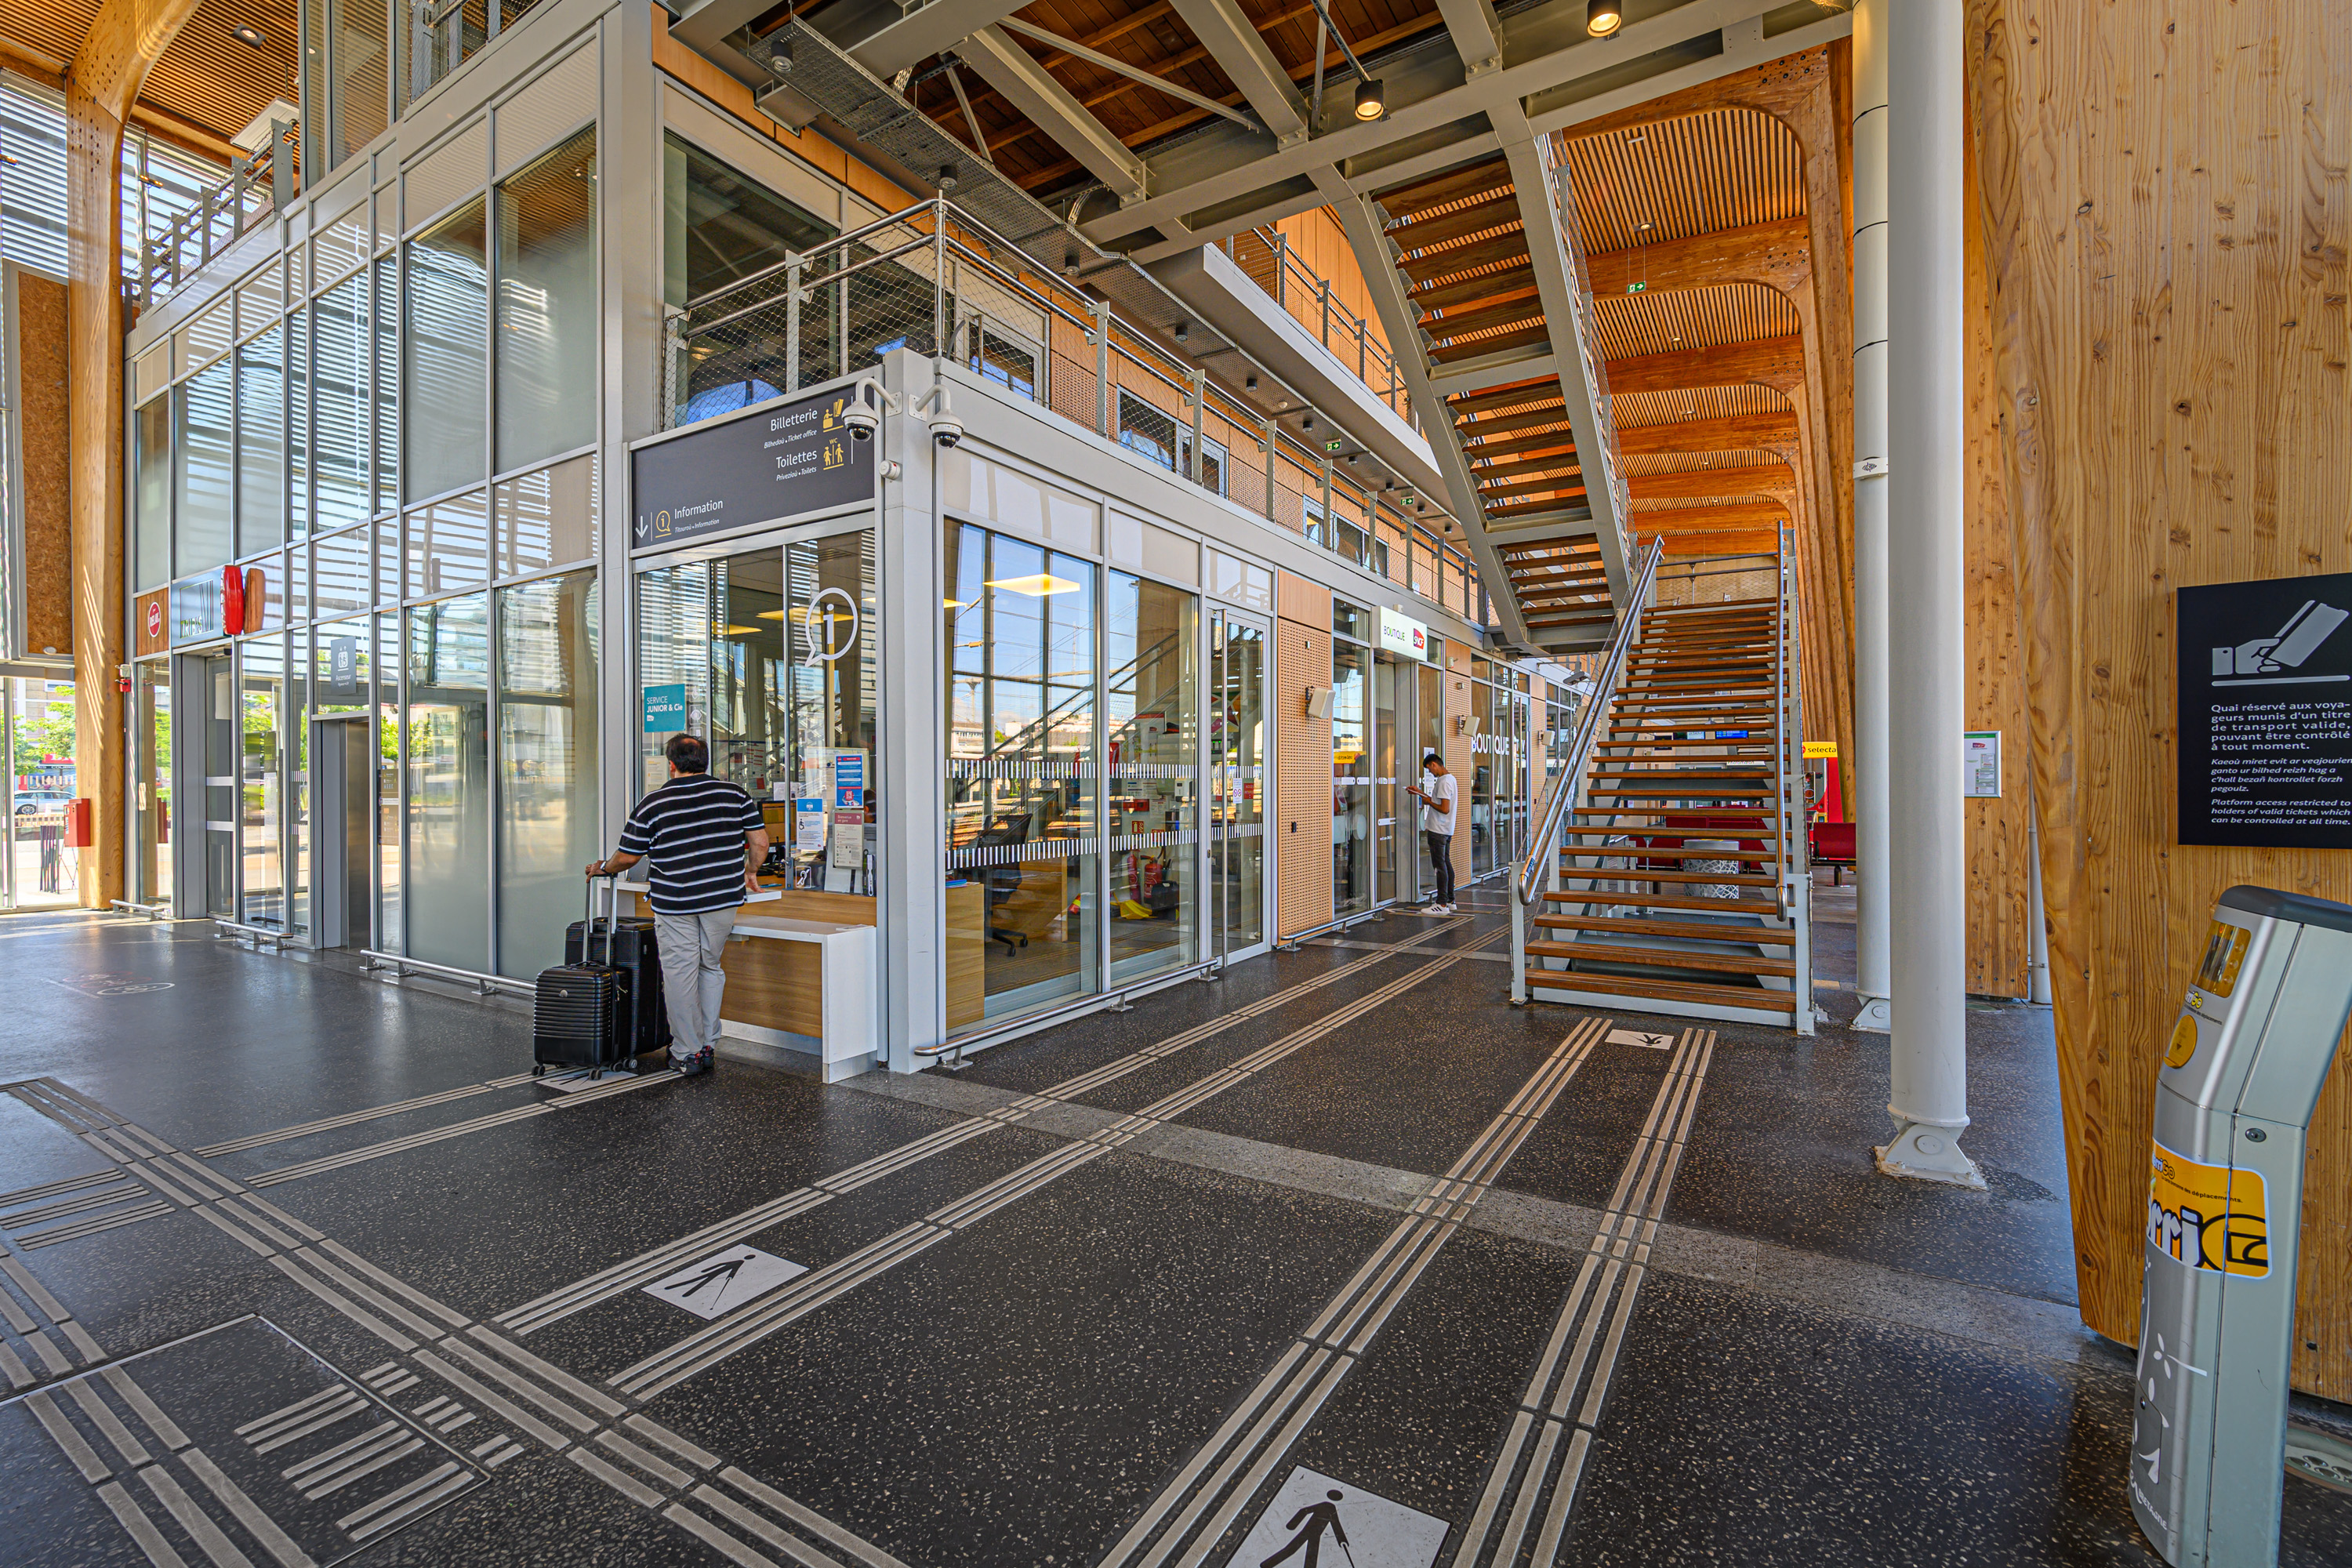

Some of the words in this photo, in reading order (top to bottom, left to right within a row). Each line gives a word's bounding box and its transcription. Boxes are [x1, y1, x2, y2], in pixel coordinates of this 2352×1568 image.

[771, 408, 817, 431] Billetterie
[764, 439, 784, 449] Bilhedoù
[788, 433, 802, 442] Ticket
[803, 430, 817, 438] office
[776, 451, 817, 468] Toilettes
[776, 472, 797, 481] Privezioù
[801, 467, 816, 475] Toilets
[675, 500, 723, 519] Information
[675, 524, 691, 533] Titouroù
[694, 518, 719, 529] Information
[1384, 626, 1405, 641] BOUTIQUE
[1414, 636, 1424, 646] SNCF
[647, 696, 668, 704] SERVICE
[647, 705, 667, 713] JUNIOR
[2211, 704, 2238, 713] Quai
[2242, 702, 2286, 711] réservé
[2232, 723, 2297, 731] transport
[2211, 733, 2261, 742] pouvant
[2295, 731, 2350, 739] contrôlé
[1472, 733, 1509, 755] BOUTQUE
[2192, 1191, 2243, 1203] déplacements.
